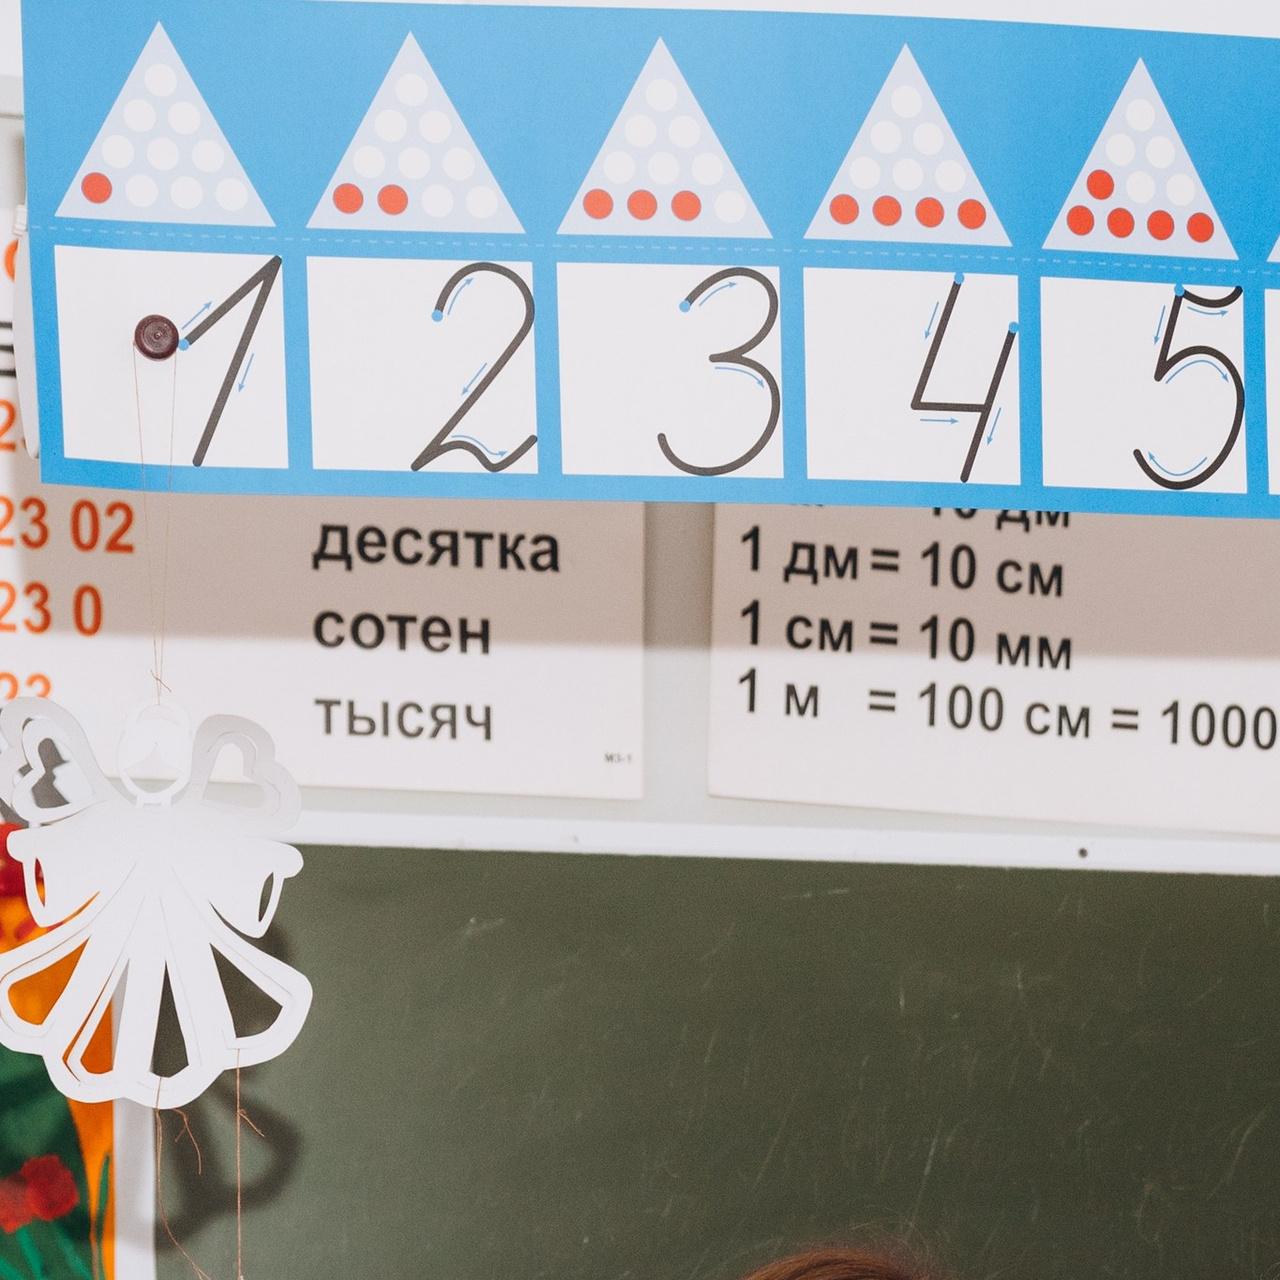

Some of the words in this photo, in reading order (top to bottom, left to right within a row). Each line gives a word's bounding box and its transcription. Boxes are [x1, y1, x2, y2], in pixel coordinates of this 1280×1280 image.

[183, 256, 282, 466] 1
[411, 262, 538, 472] 2
[658, 267, 780, 476] 3
[911, 273, 1018, 482] 4
[1133, 286, 1245, 490] 5
[71, 500, 134, 554] 02
[312, 523, 560, 574] десятка
[741, 525, 760, 572] 1
[784, 541, 858, 585] дм
[921, 541, 977, 590] 10
[996, 560, 1063, 598] см
[312, 610, 491, 655] сотен
[741, 599, 760, 646] 1
[785, 616, 854, 653] см
[920, 614, 976, 662] 10
[996, 632, 1073, 670] мм
[314, 697, 492, 742] тысяч
[739, 667, 757, 713] 1
[785, 683, 819, 718] м
[919, 682, 1004, 732] 100
[1025, 703, 1091, 740] см
[1161, 700, 1278, 751] 1000
